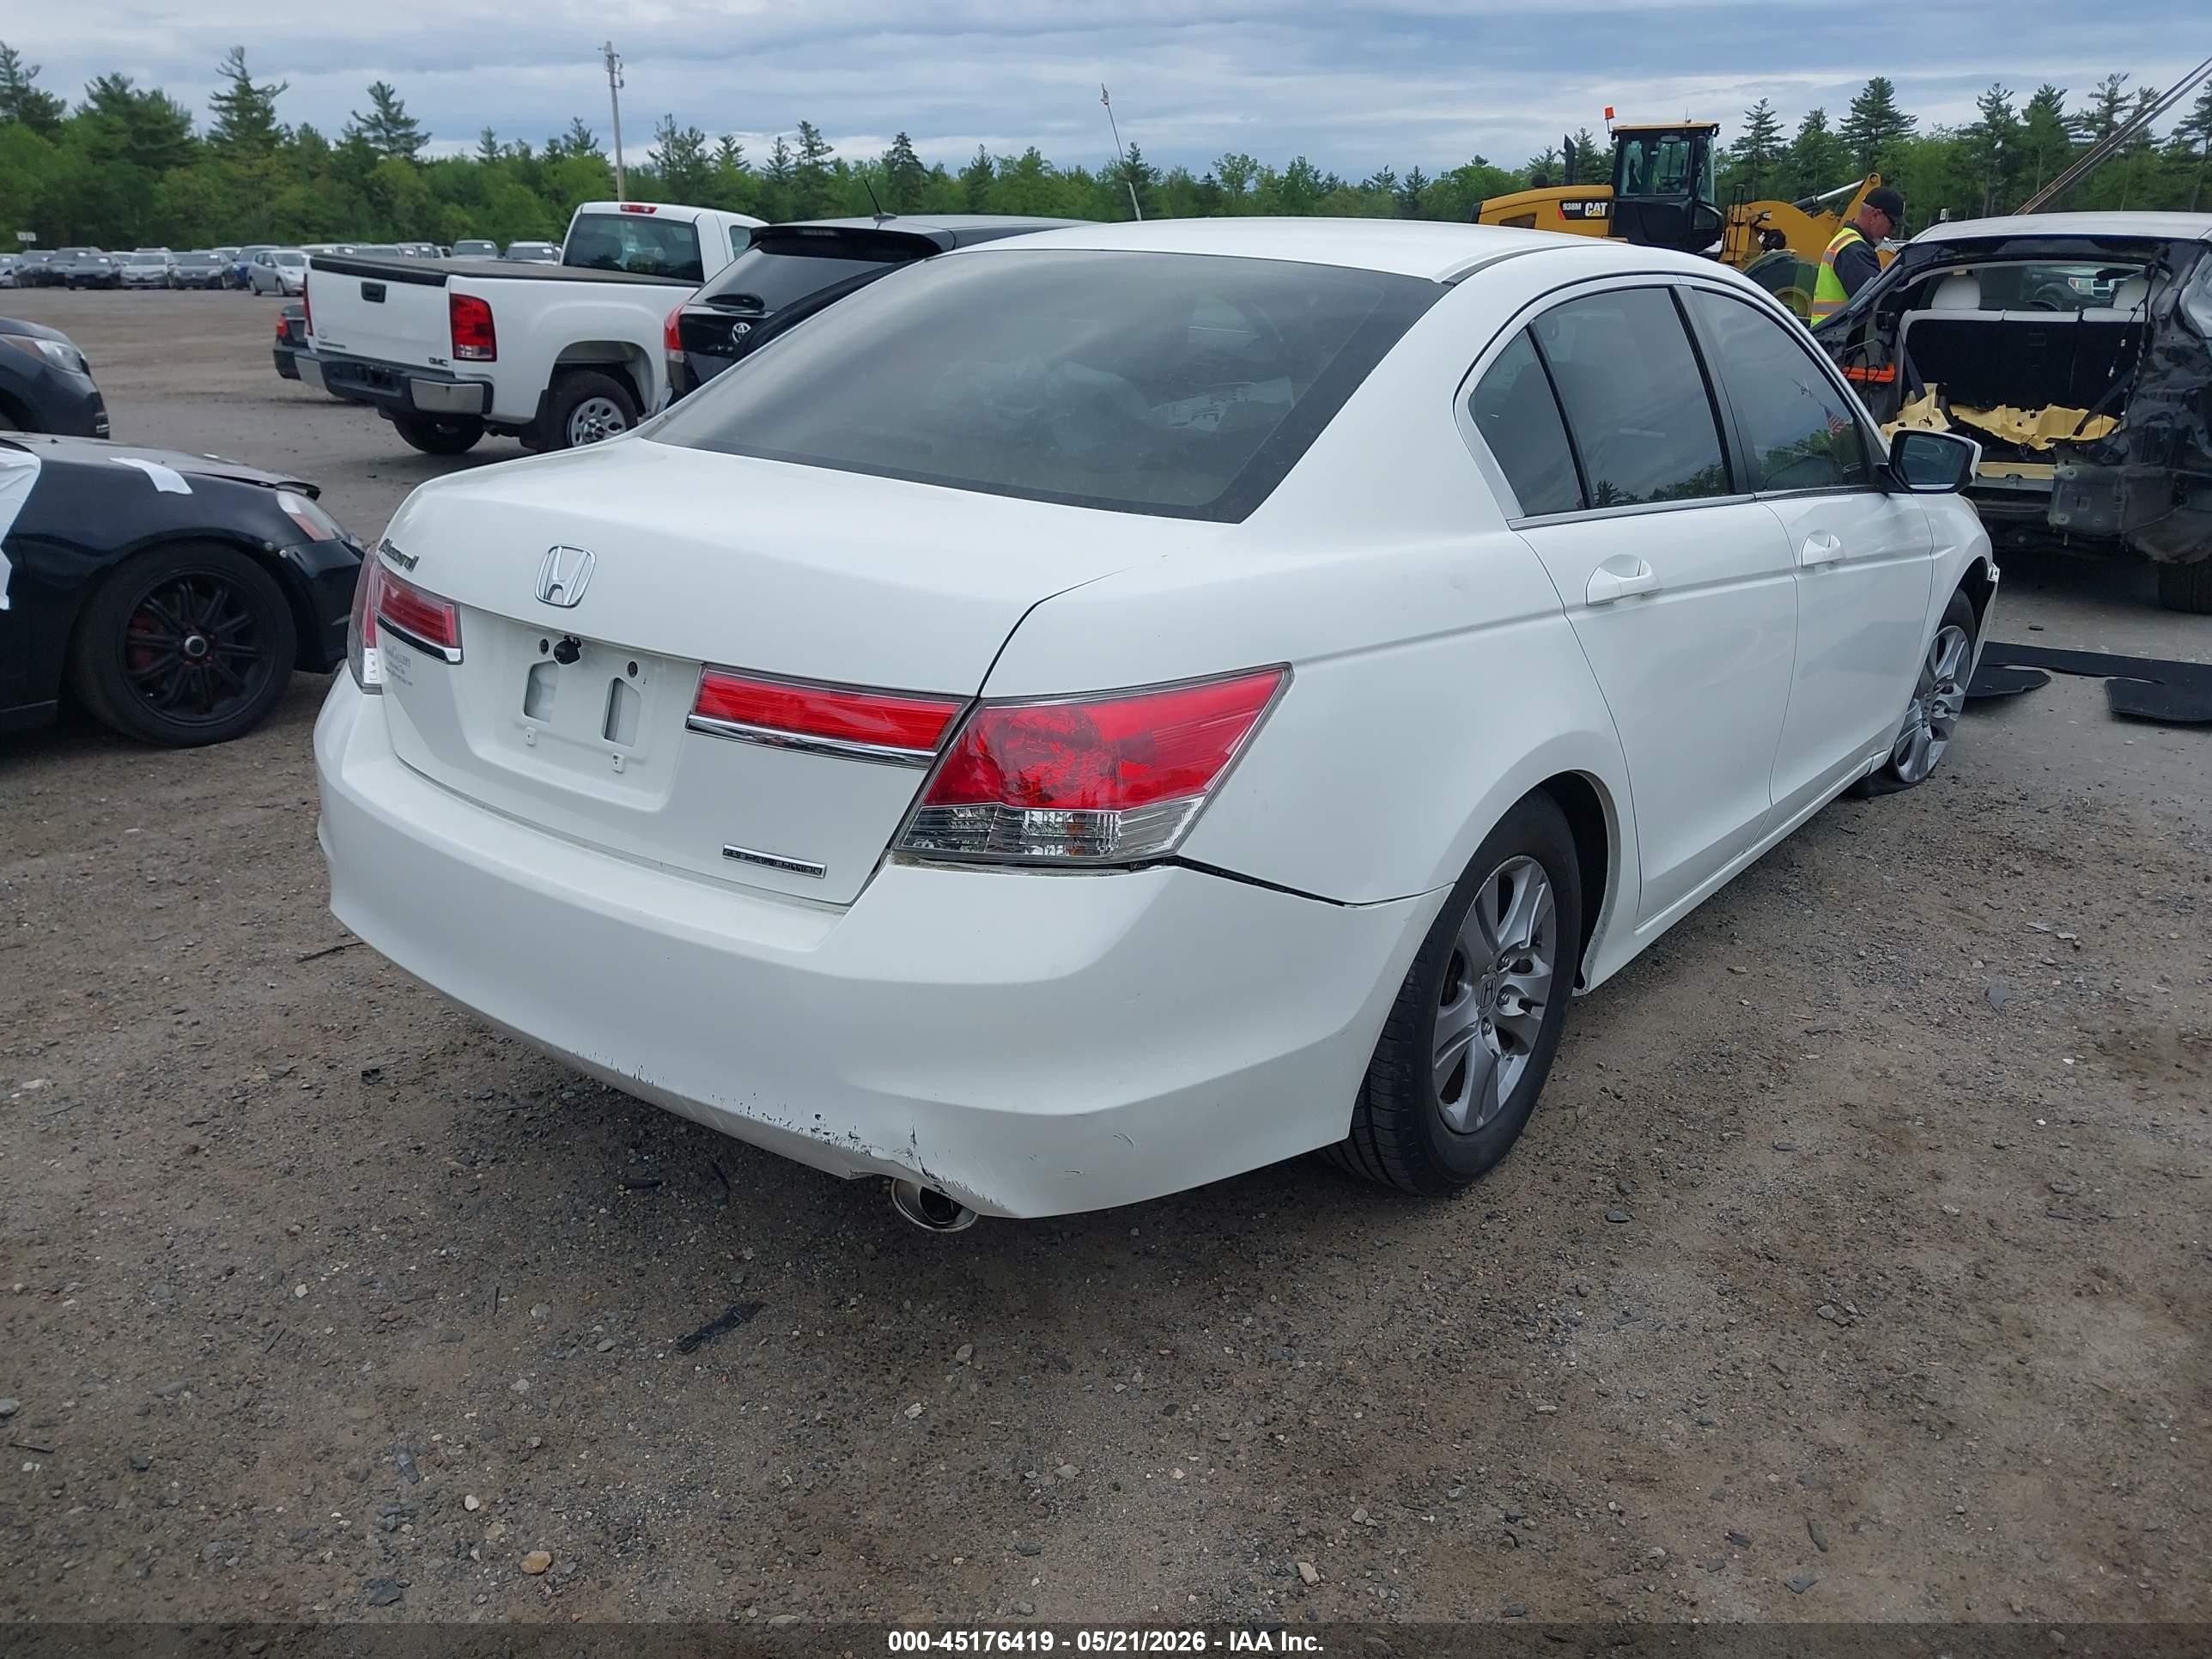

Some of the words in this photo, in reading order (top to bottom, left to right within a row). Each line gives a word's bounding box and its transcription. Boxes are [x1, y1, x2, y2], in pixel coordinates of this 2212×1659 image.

[1584, 202, 1608, 216] CAT
[428, 356, 449, 368] GMC
[773, 860, 823, 876] EDITION
